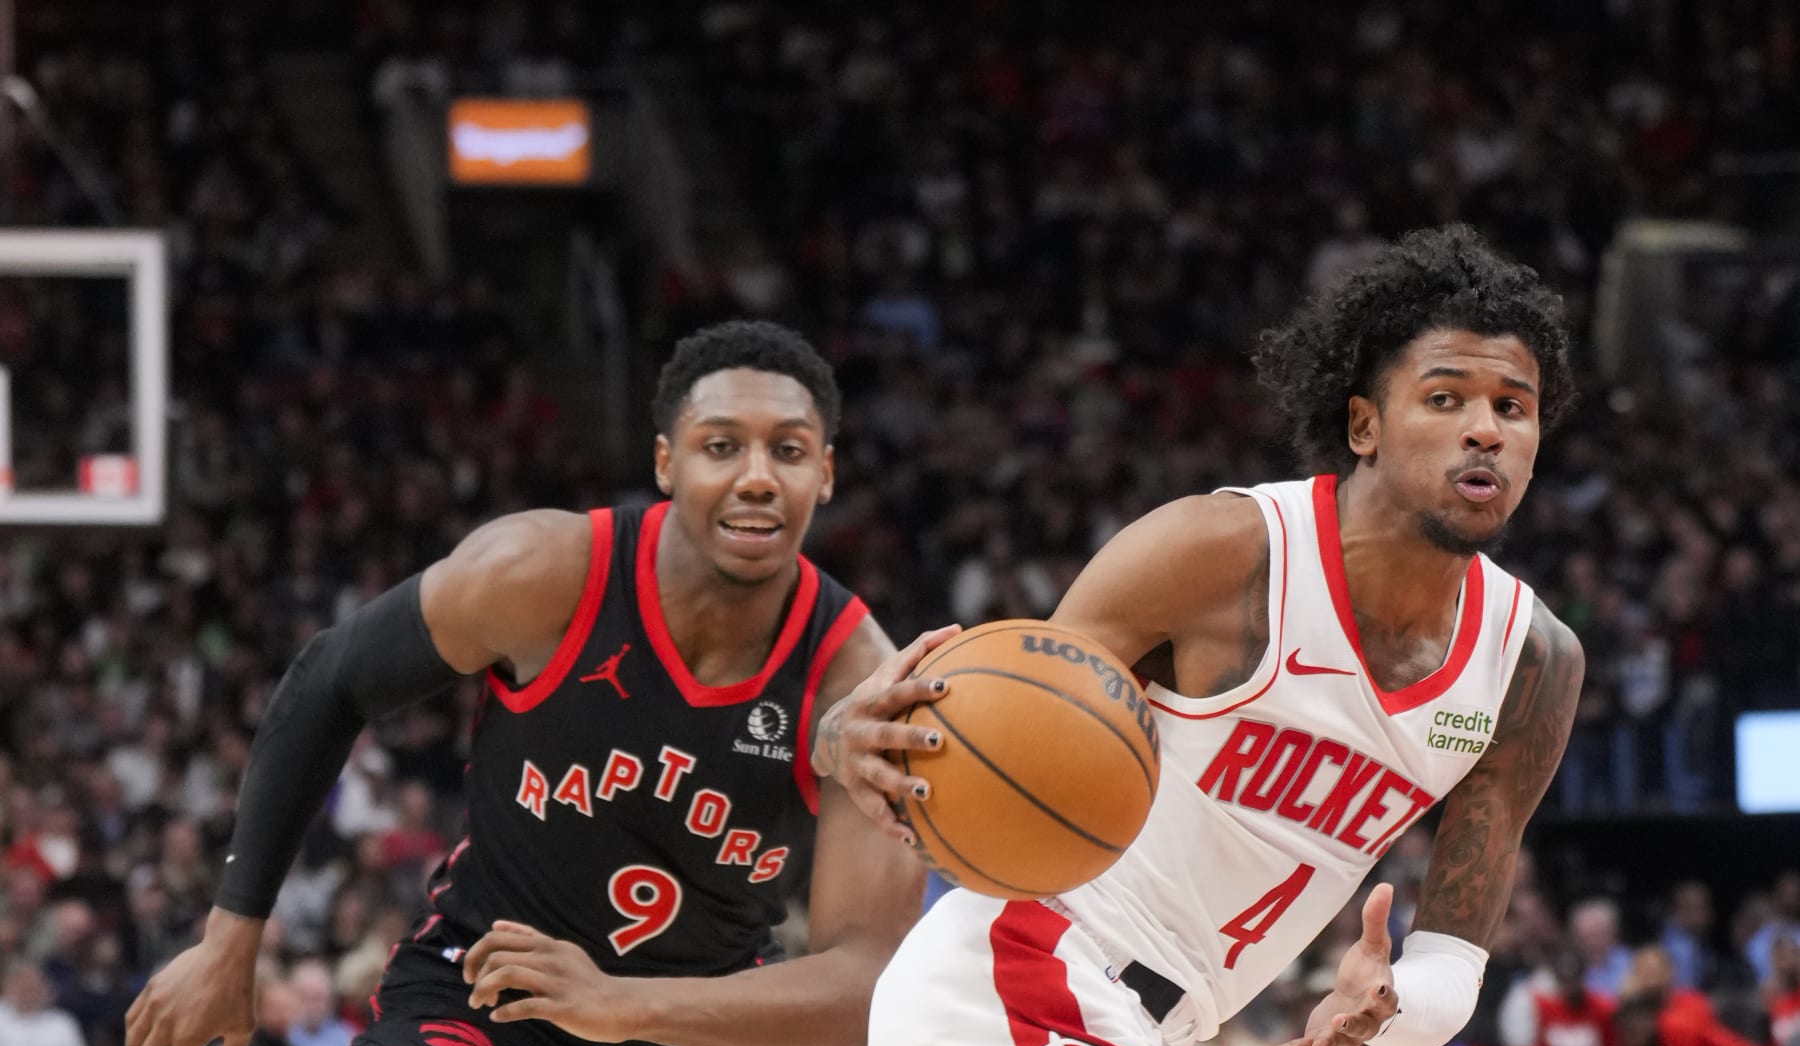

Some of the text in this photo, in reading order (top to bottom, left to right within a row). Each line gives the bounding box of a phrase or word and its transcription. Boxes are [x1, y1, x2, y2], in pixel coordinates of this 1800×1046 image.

[732, 738, 793, 762] Sun Life
[1427, 727, 1485, 754] karma
[1434, 711, 1492, 734] credit
[516, 745, 790, 884] RAPTORS
[1196, 718, 1437, 859] ROCKET
[607, 864, 683, 957] 9
[1219, 863, 1316, 970] 4
